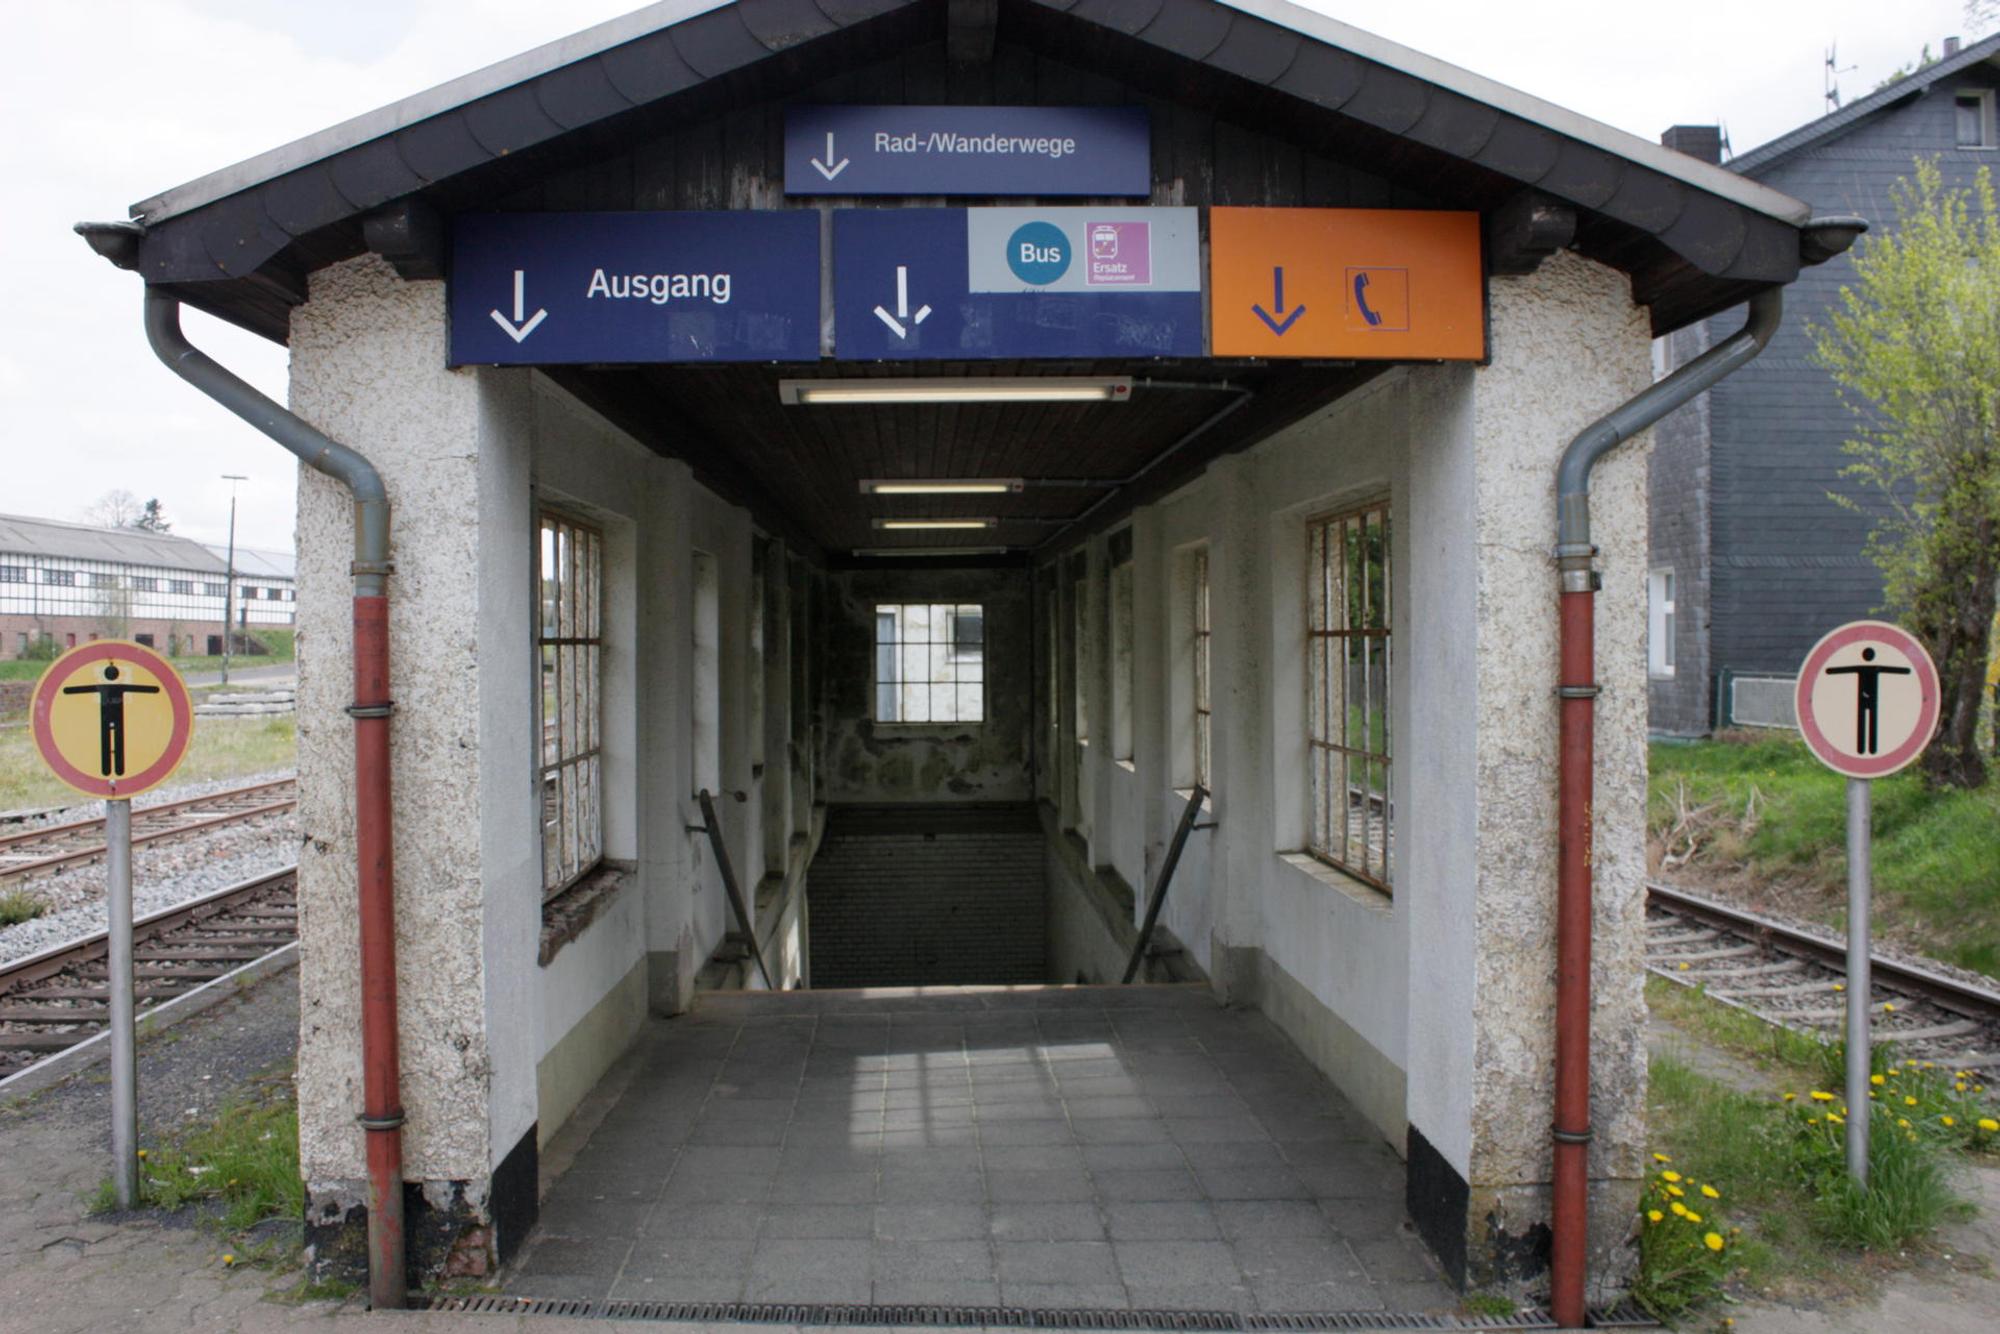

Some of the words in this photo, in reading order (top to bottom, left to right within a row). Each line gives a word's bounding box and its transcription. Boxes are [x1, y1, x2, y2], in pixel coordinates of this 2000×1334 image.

[875, 133, 1076, 158] Rad-/Wanderwege
[1020, 243, 1061, 263] Bus
[1093, 262, 1128, 273] Ersatz
[587, 268, 731, 305] Ausgang
